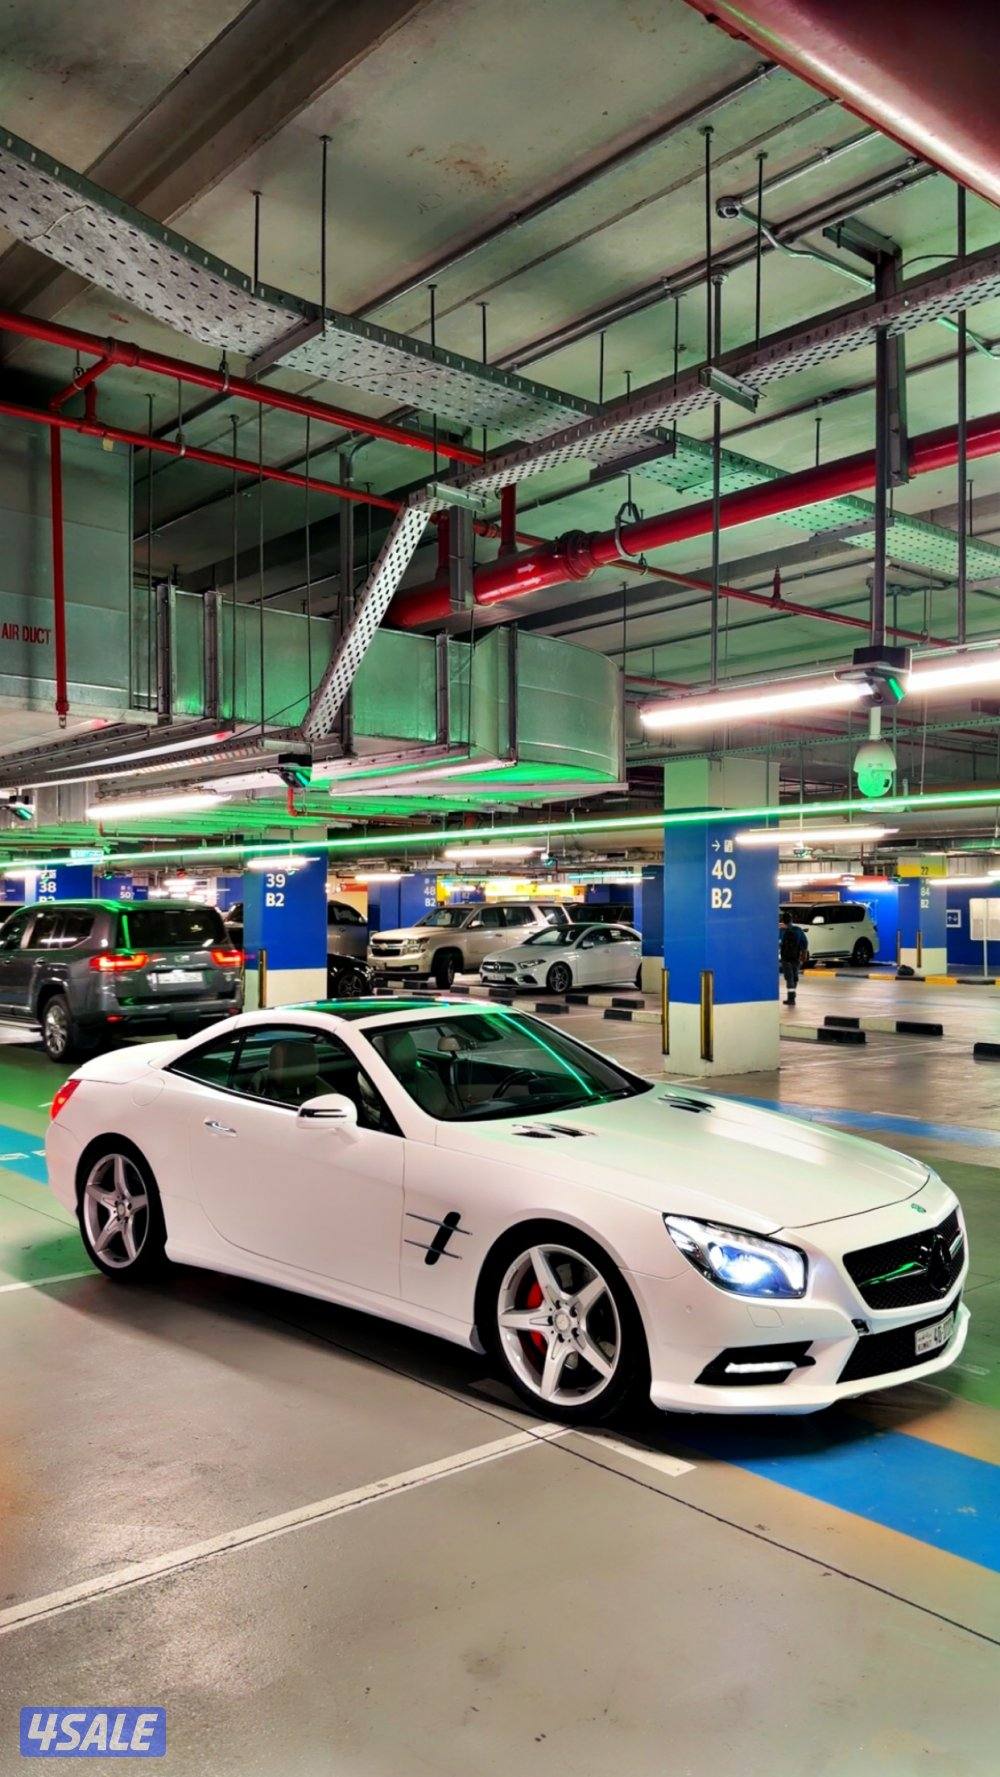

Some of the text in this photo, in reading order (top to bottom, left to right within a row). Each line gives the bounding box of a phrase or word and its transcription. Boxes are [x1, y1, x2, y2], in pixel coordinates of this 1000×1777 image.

[1, 622, 51, 645] AIR DUCT
[711, 859, 736, 880] 40
[38, 881, 57, 893] 38
[266, 873, 286, 888] 39
[265, 892, 285, 907] B2
[711, 887, 732, 909] B2
